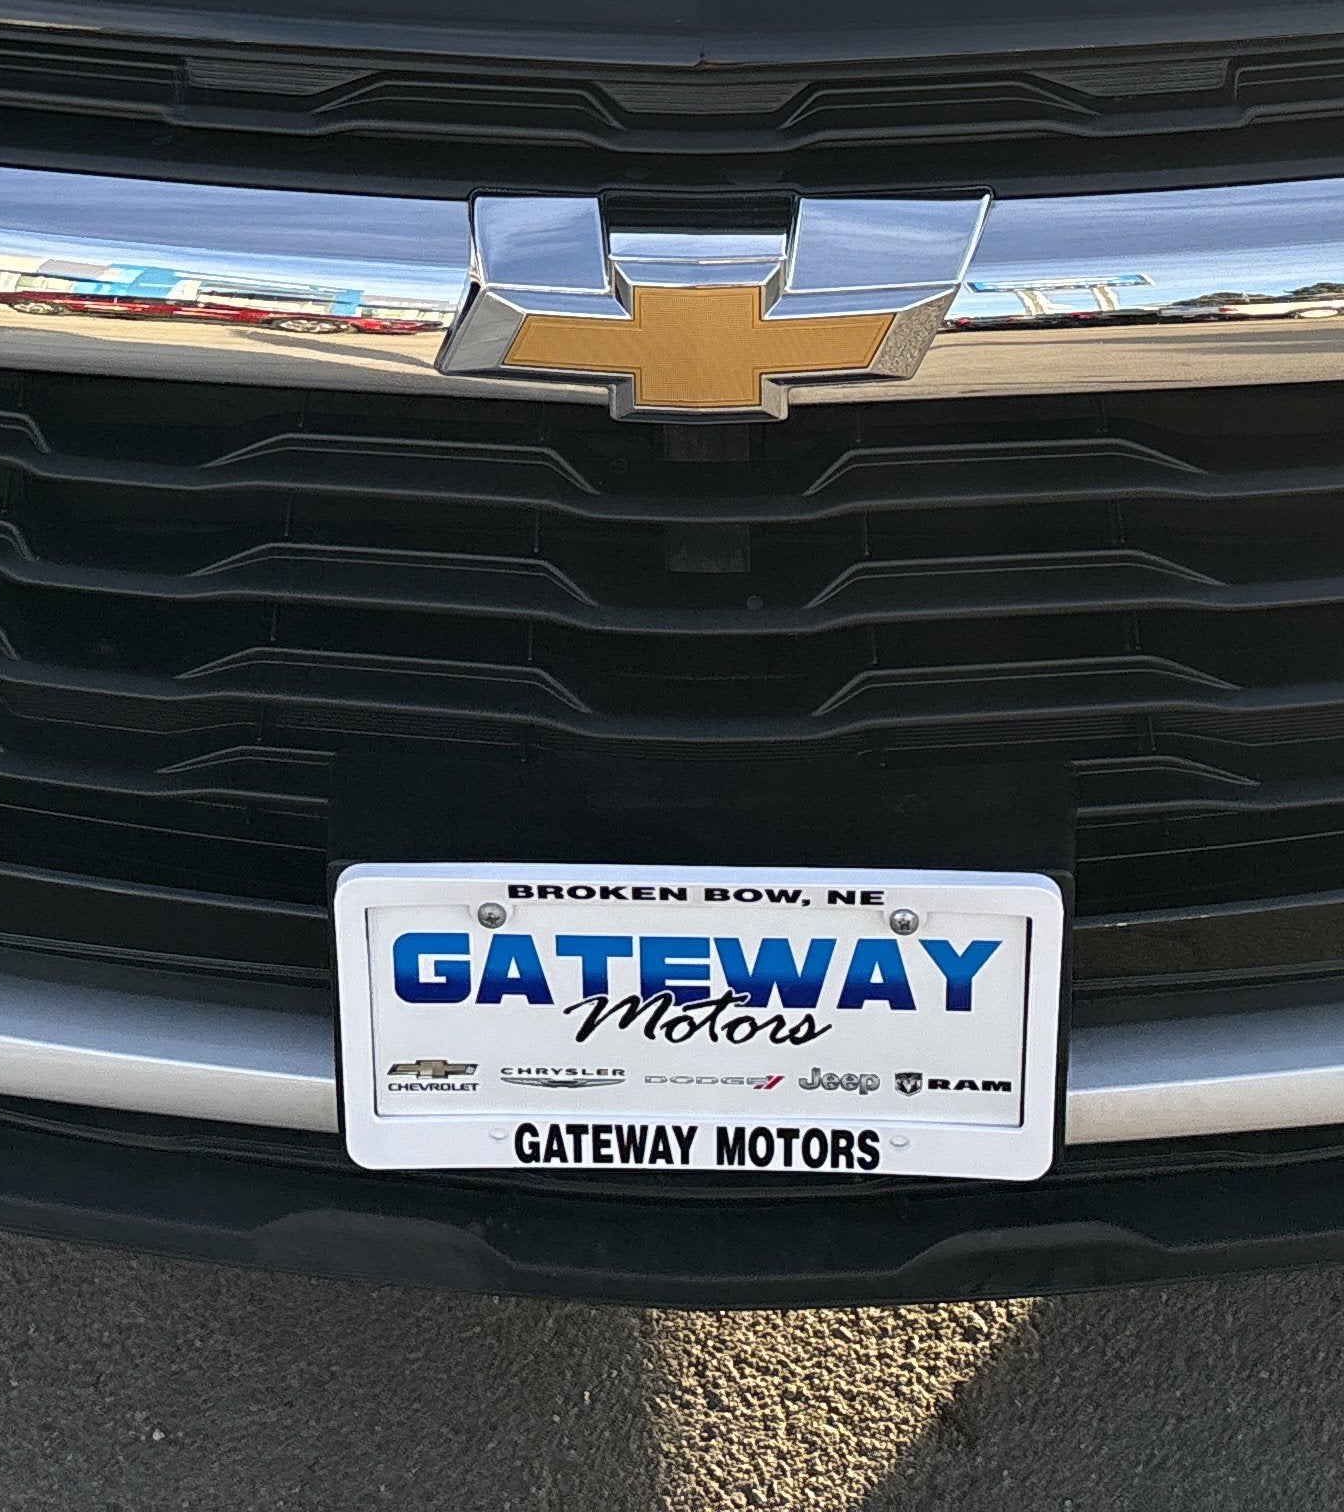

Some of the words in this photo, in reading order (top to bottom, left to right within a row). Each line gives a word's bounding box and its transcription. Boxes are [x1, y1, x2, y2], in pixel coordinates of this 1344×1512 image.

[507, 884, 688, 902] BROKEN
[704, 887, 811, 907] BOW,
[827, 890, 885, 905] NE
[392, 931, 1004, 1012] GATEWAY
[562, 987, 833, 1046] Motors
[500, 1066, 627, 1077] CHRYSLER
[644, 1074, 769, 1087] DODGE
[797, 1067, 881, 1095] Jeep
[387, 1082, 480, 1092] CHEVROLET
[927, 1077, 1012, 1092] RAM
[514, 1122, 699, 1166] GATEWAY
[715, 1125, 881, 1171] MOTORS
